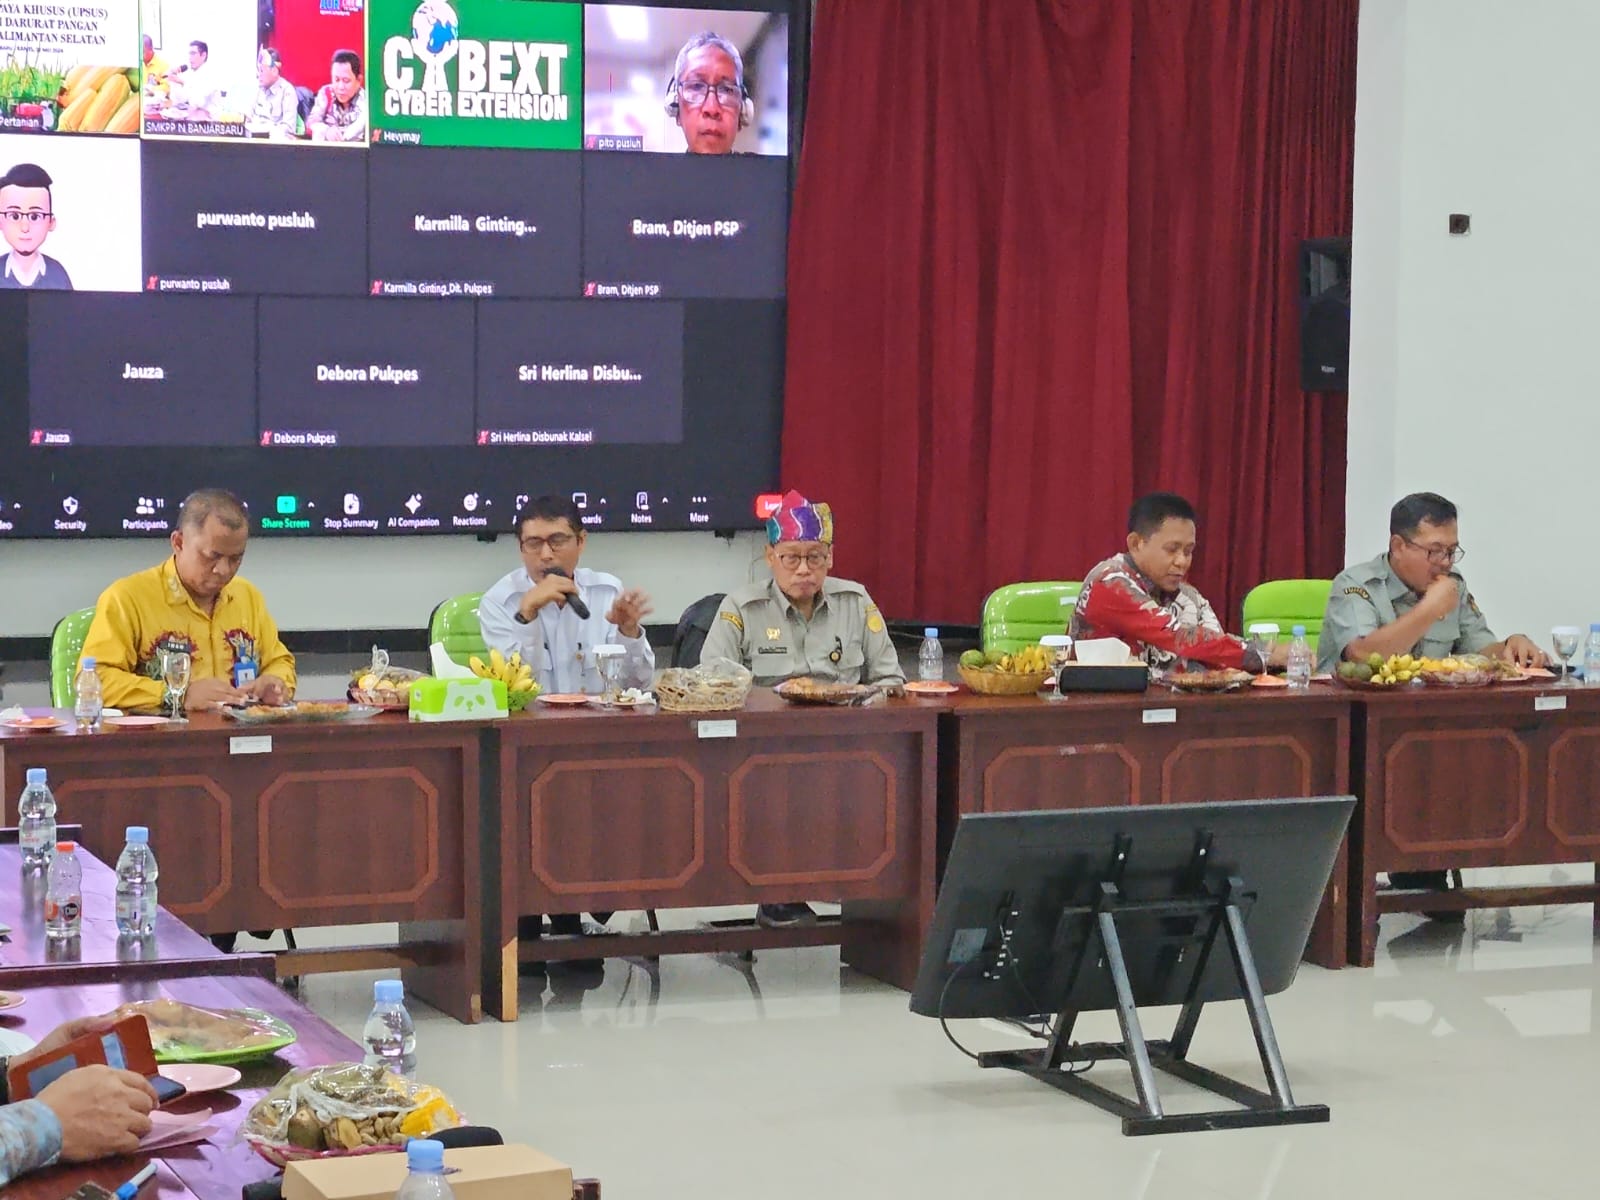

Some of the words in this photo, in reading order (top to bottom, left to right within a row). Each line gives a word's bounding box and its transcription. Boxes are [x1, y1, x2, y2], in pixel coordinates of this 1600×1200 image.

[24, 4, 65, 16] KHUSUS
[68, 7, 108, 20] (UPSUS)
[6, 17, 55, 29] DARURAT
[58, 20, 98, 30] PANGAN
[60, 34, 106, 44] SELATAN
[384, 90, 452, 116] CYBER
[458, 92, 568, 120] EXTENSION
[188, 124, 244, 136] BANJARBARU
[197, 212, 265, 228] purwanto
[268, 212, 314, 230] pusluh
[414, 216, 470, 232] Karmilla
[633, 220, 669, 236] Bram,
[673, 220, 711, 238] Ditjen
[714, 222, 739, 236] PSP
[160, 279, 200, 290] purwanto
[384, 282, 416, 294] Karmilla
[621, 284, 642, 297] Ditjen
[645, 284, 658, 296] PSP
[122, 363, 164, 380] Jauza
[317, 366, 366, 382] Debora
[370, 366, 418, 384] Pukpes
[519, 366, 537, 380] Sri
[542, 366, 588, 380] Herlina
[593, 366, 642, 381] Disbu...
[45, 432, 70, 443] Jauza
[274, 432, 304, 444] Debora
[306, 432, 336, 446] Pukpes
[490, 432, 502, 442] Sri
[504, 432, 530, 442] Herlina
[532, 432, 567, 443] Disbunak
[569, 431, 592, 442] Kalsel
[262, 518, 283, 528] Share
[285, 518, 310, 528] Screen
[324, 518, 342, 530] Stop
[343, 518, 378, 530] Summary
[388, 518, 396, 527] AI
[399, 518, 440, 528] Companion
[453, 516, 487, 526] Reactions
[631, 512, 652, 524] Notes
[690, 512, 708, 524] More
[54, 519, 86, 532] Security
[123, 519, 168, 531] Participants
